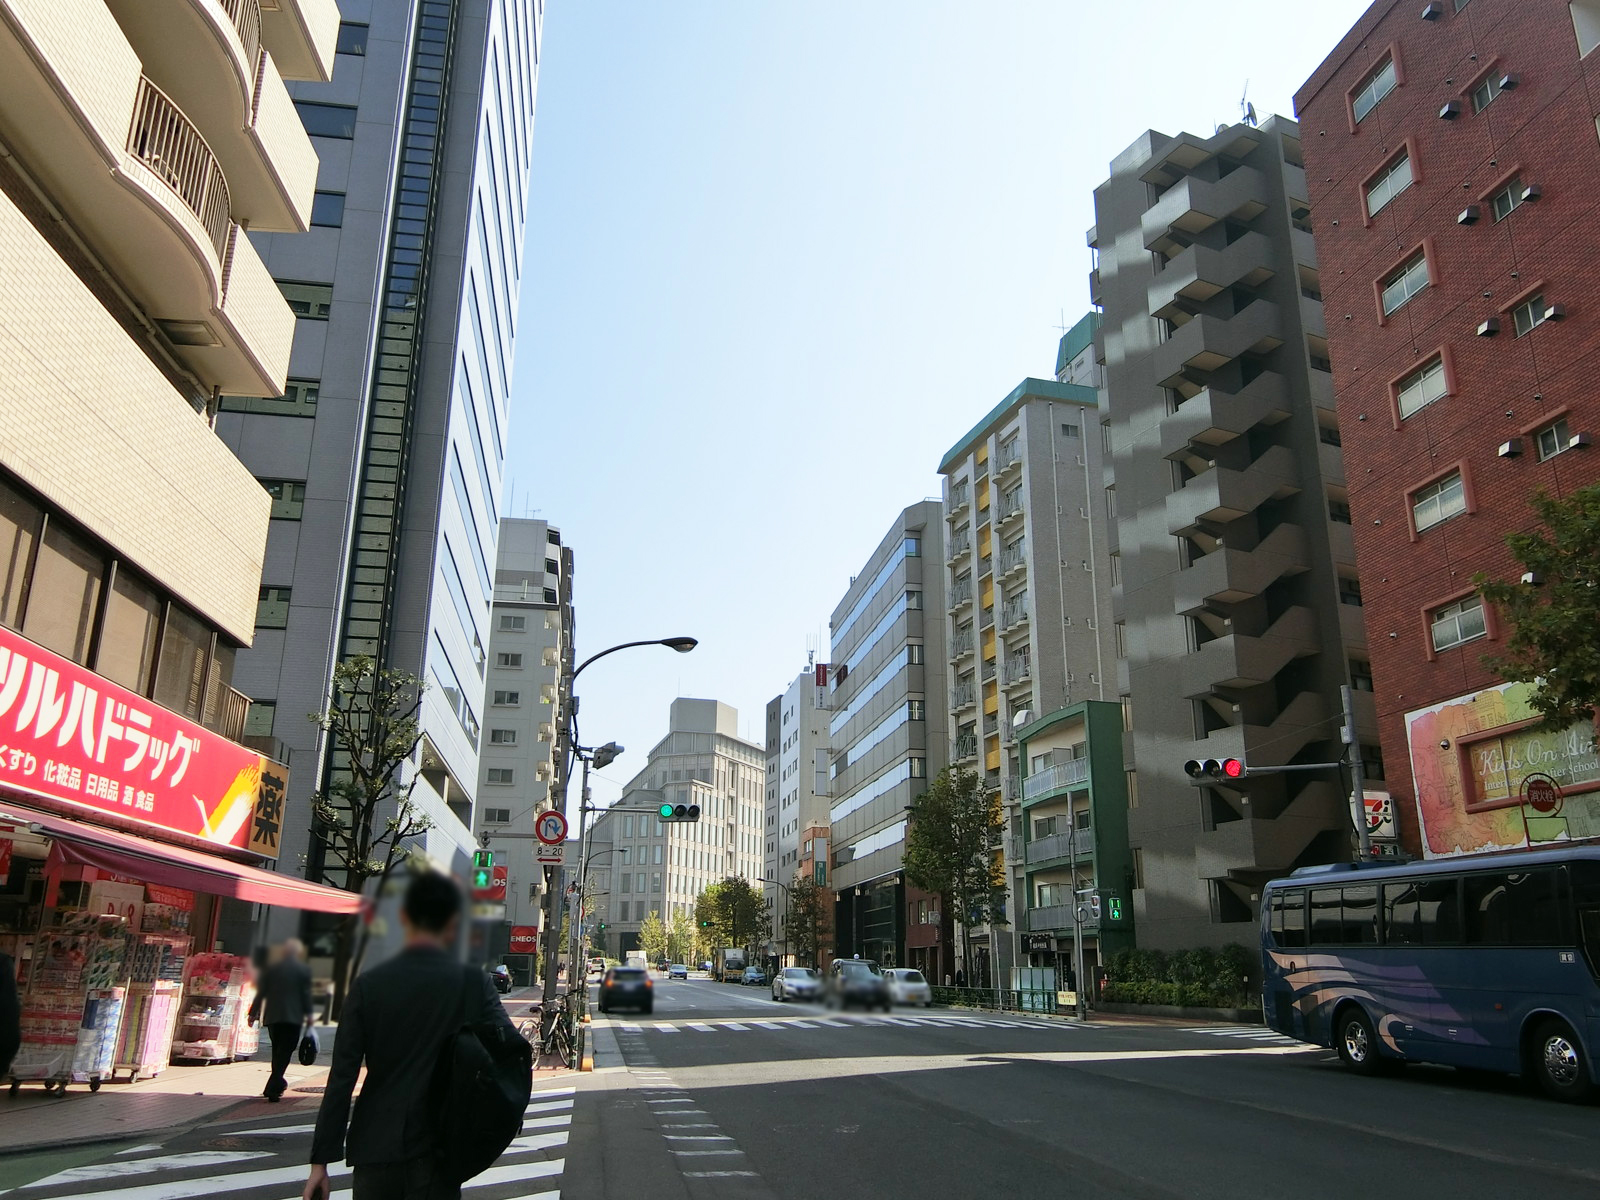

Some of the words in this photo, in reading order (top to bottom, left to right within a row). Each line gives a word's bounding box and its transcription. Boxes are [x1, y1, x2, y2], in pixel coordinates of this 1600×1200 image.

[1480, 746, 1523, 776] Kids
[1527, 739, 1558, 766] On
[1561, 731, 1598, 758] Air
[1544, 767, 1566, 778] After
[1568, 758, 1599, 775] School
[0, 744, 37, 776] くすり
[43, 759, 82, 791] 化粧品
[85, 773, 119, 802] 日用品
[122, 785, 135, 807] 酒
[135, 790, 155, 812] 食品
[253, 771, 284, 848] 薬
[1529, 789, 1554, 802] 消火栓
[511, 935, 537, 943] ENEOS
